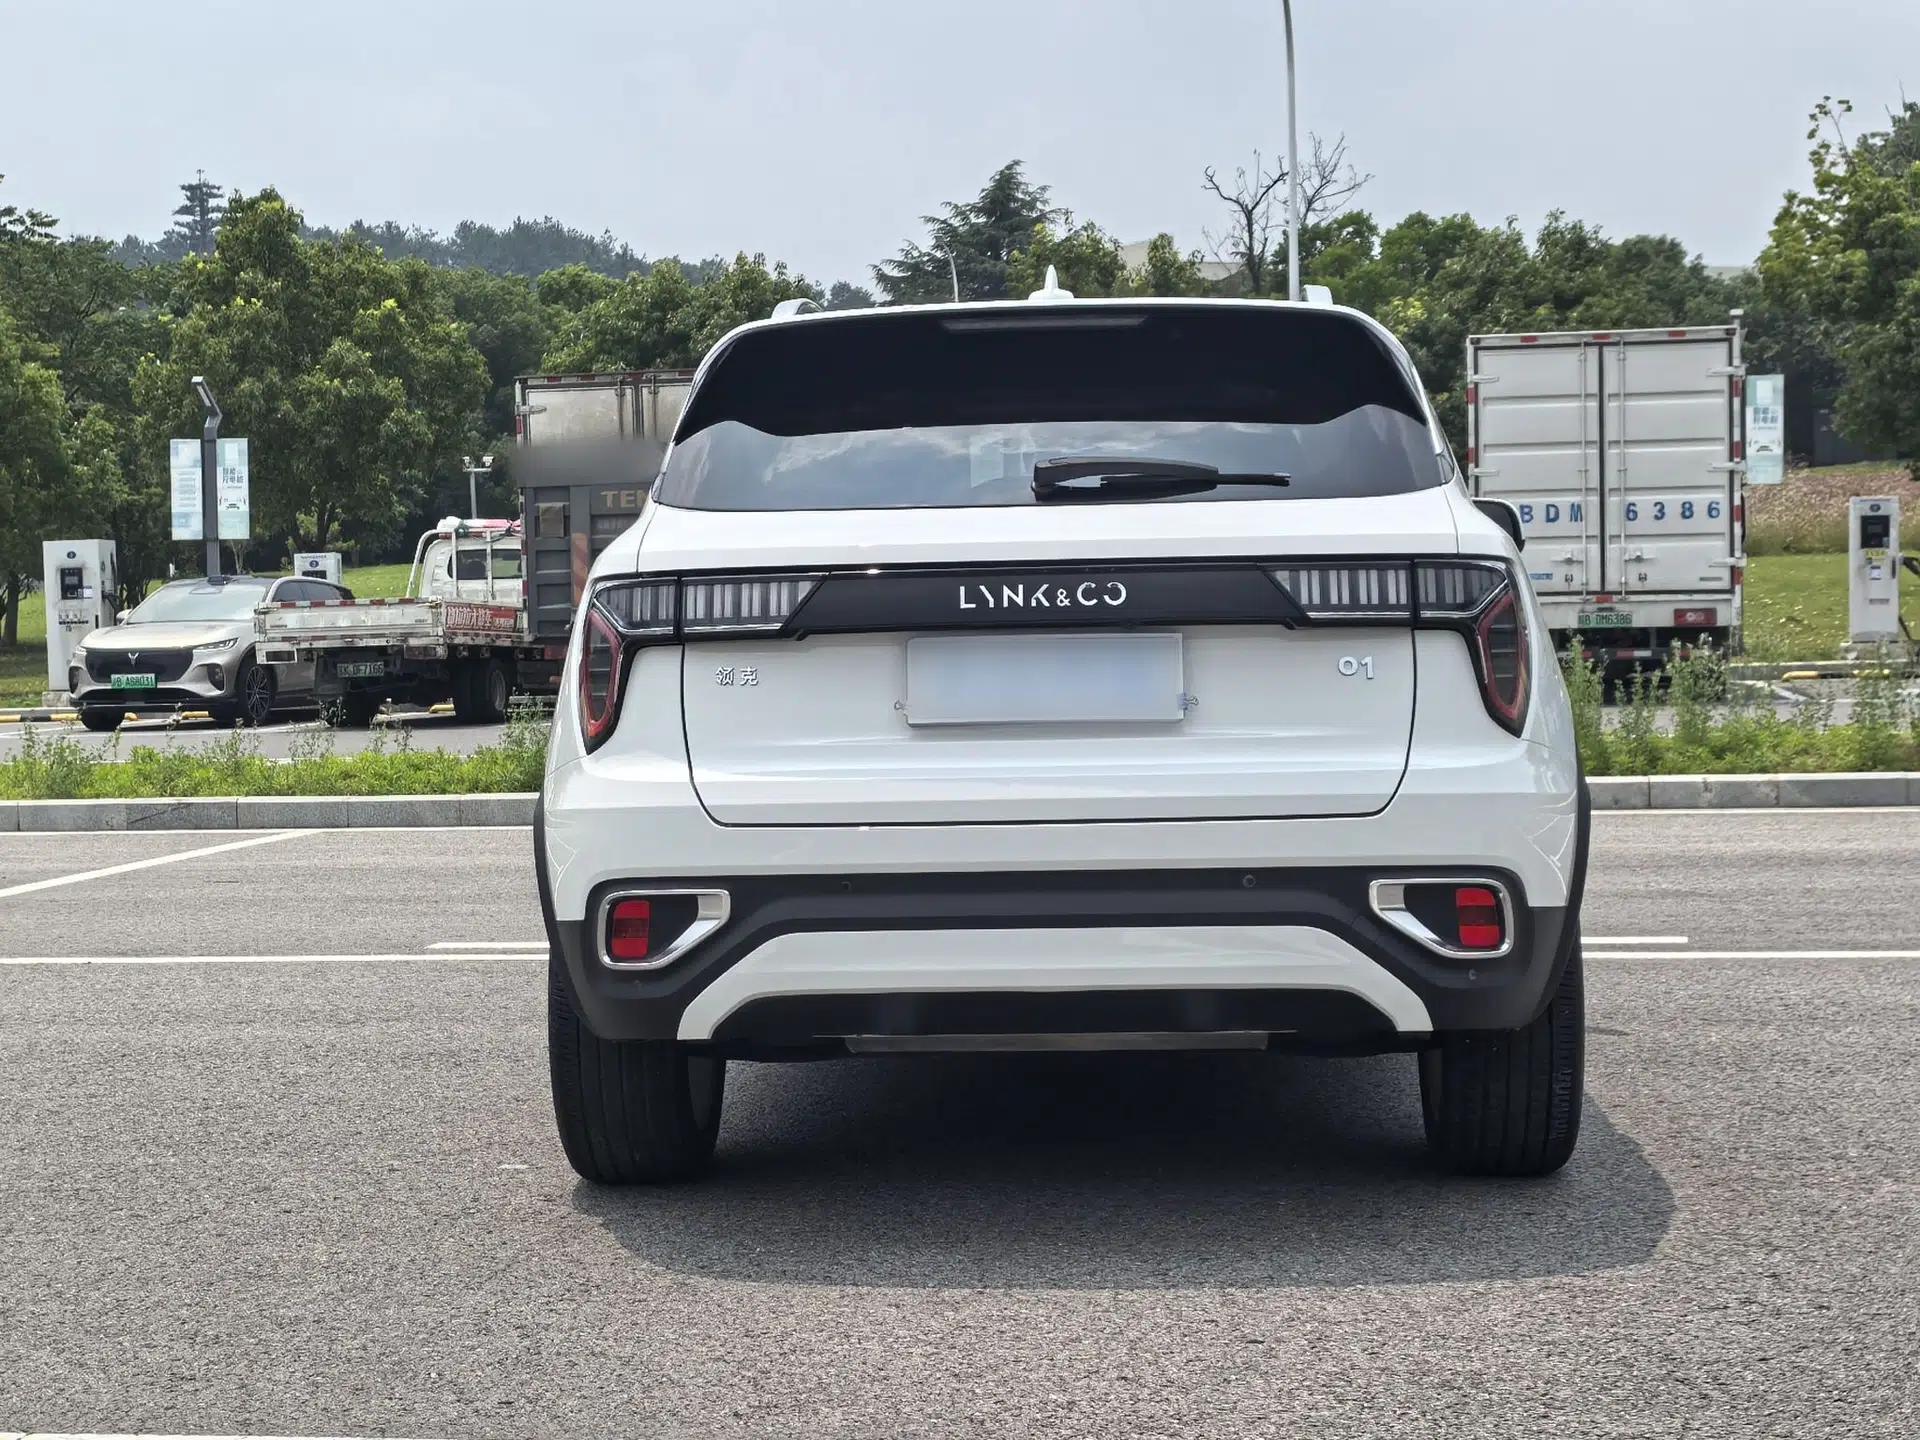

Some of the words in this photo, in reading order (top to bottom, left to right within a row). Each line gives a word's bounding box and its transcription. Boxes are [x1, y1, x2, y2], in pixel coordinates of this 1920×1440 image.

[1625, 501, 1721, 521] 6386
[959, 581, 1127, 609] LYNK&CO
[715, 662, 760, 687] 领克
